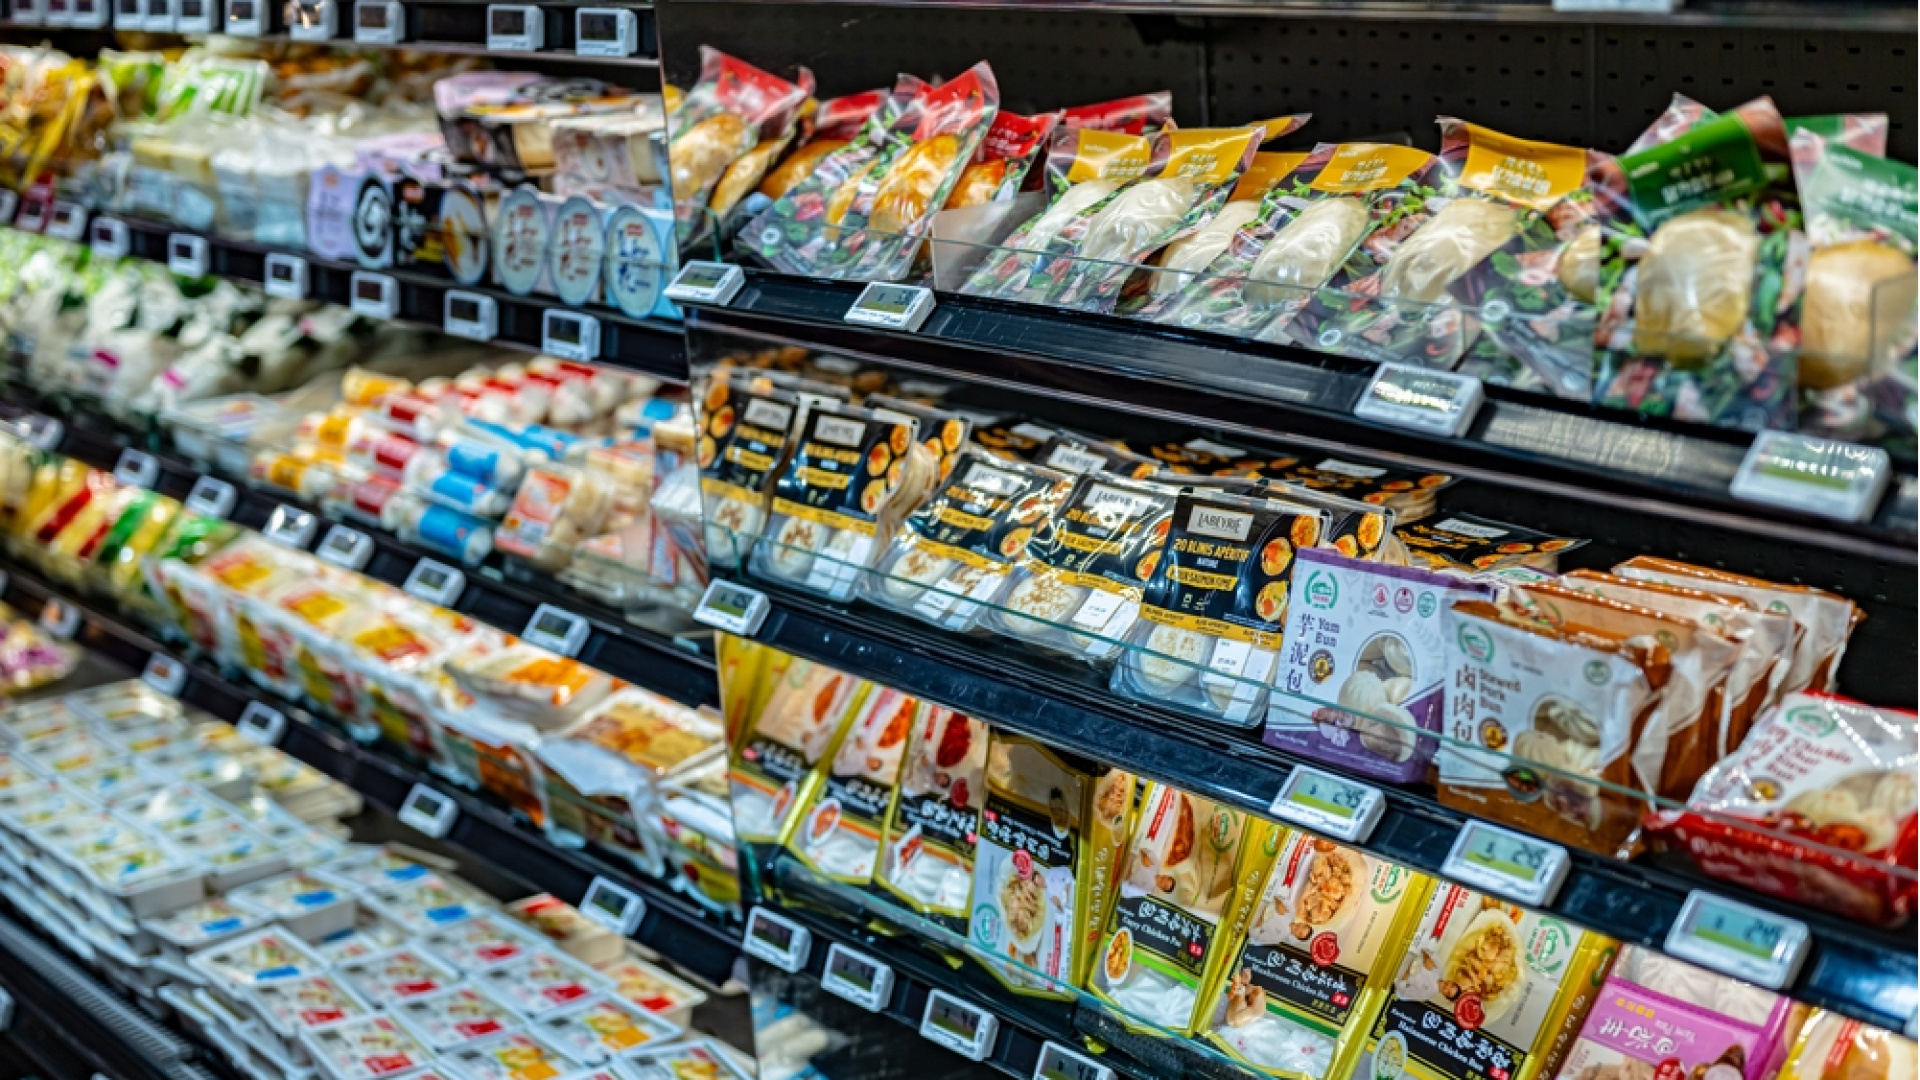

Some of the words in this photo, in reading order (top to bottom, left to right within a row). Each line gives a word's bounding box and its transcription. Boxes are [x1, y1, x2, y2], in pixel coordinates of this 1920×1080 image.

[1197, 513, 1243, 533] LABEYRIE
[1173, 538, 1187, 552] 20
[1187, 541, 1214, 556] BLINIS
[1318, 617, 1340, 633] Yam
[1480, 682, 1506, 701] Pork
